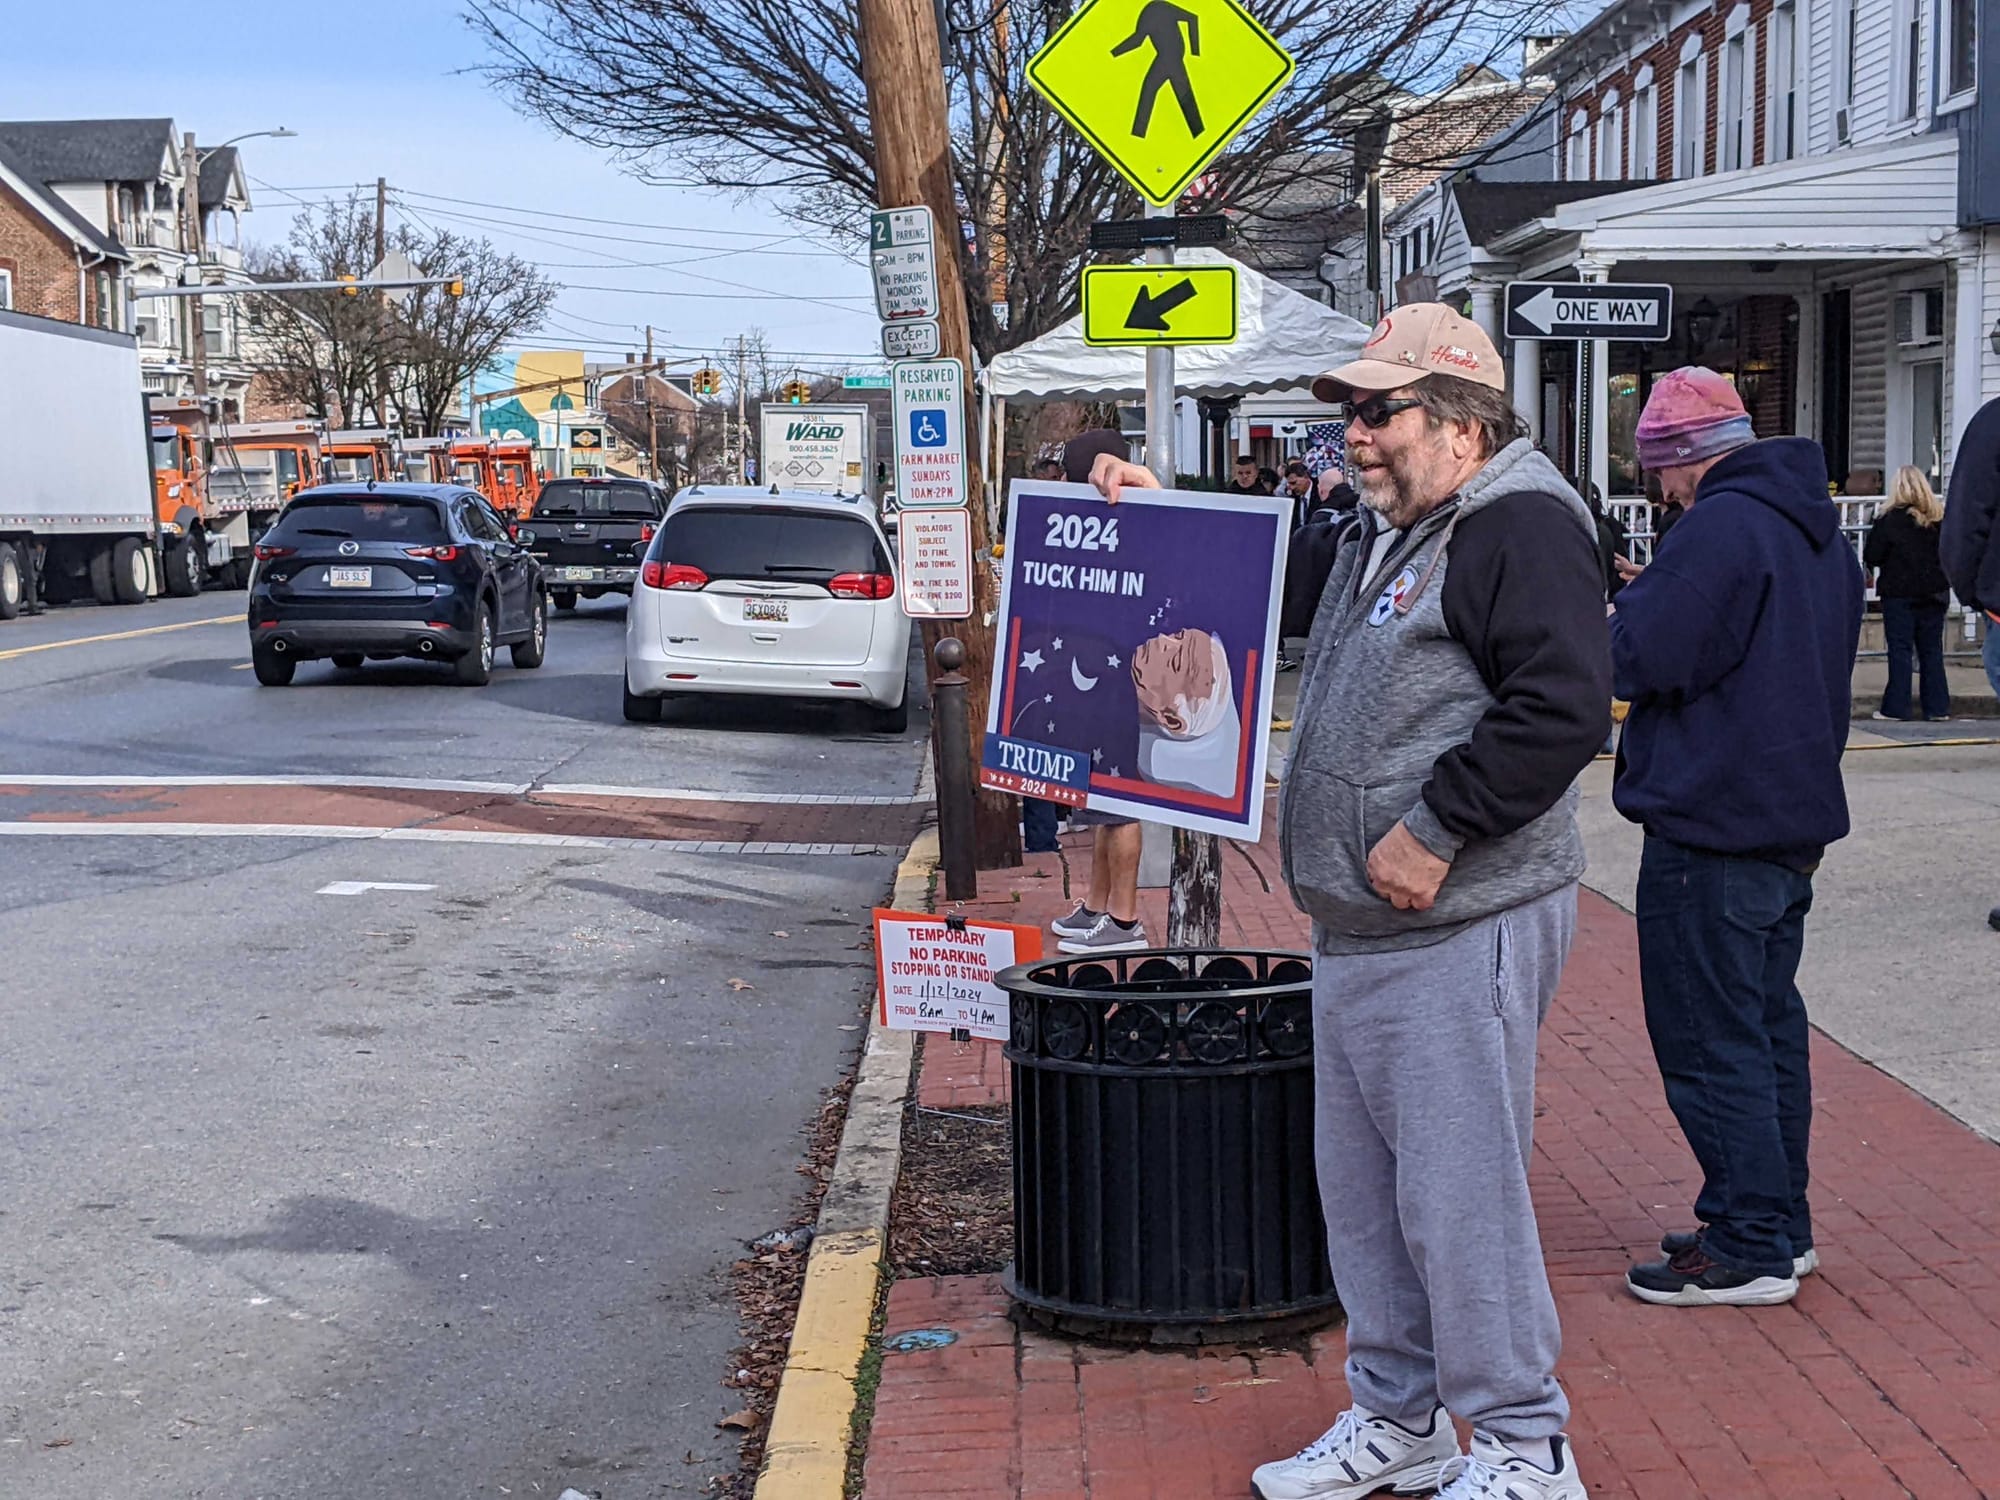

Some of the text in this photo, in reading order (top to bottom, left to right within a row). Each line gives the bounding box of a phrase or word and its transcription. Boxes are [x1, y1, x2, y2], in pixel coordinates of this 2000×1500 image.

[904, 215, 914, 226] HR
[874, 220, 887, 242] 2
[896, 228, 926, 241] PARKING
[907, 252, 925, 263] 8PM
[880, 271, 928, 286] NO PARKING
[886, 284, 923, 297] MONDAYS
[884, 300, 900, 311] 7AM
[911, 297, 929, 308] 9AM
[1556, 301, 1652, 322] ONE WAY
[887, 328, 930, 343] EXCEPT
[890, 342, 929, 352] HOLIDAYS
[900, 368, 954, 383] RESERVED
[904, 388, 952, 403] PARKING
[785, 423, 844, 441] WARD
[901, 452, 961, 466] FARM MARKET
[911, 470, 951, 482] SUNDAYS
[910, 486, 954, 499] 10AM-2PM
[915, 524, 953, 534] VIOLATORS
[1045, 512, 1119, 552] 2024
[918, 537, 946, 545] SUBJECT
[918, 548, 949, 557] TO FINE
[914, 560, 957, 569] AND TOWING
[928, 579, 942, 587] FINE
[945, 579, 959, 587] $50
[1023, 560, 1145, 597] TUCK HIM IN
[927, 592, 941, 600] FINE
[944, 591, 963, 600] $200
[999, 740, 1075, 782] TRUMP
[1020, 777, 1047, 796] 2024
[907, 927, 986, 947] TEMPORARY
[909, 947, 987, 966] NO PARKING
[891, 961, 941, 977] STOPPING
[944, 966, 958, 978] OR
[893, 979, 982, 1003] DATE 1/12/2024
[895, 1005, 916, 1016] FROM
[958, 1009, 968, 1020] TO
